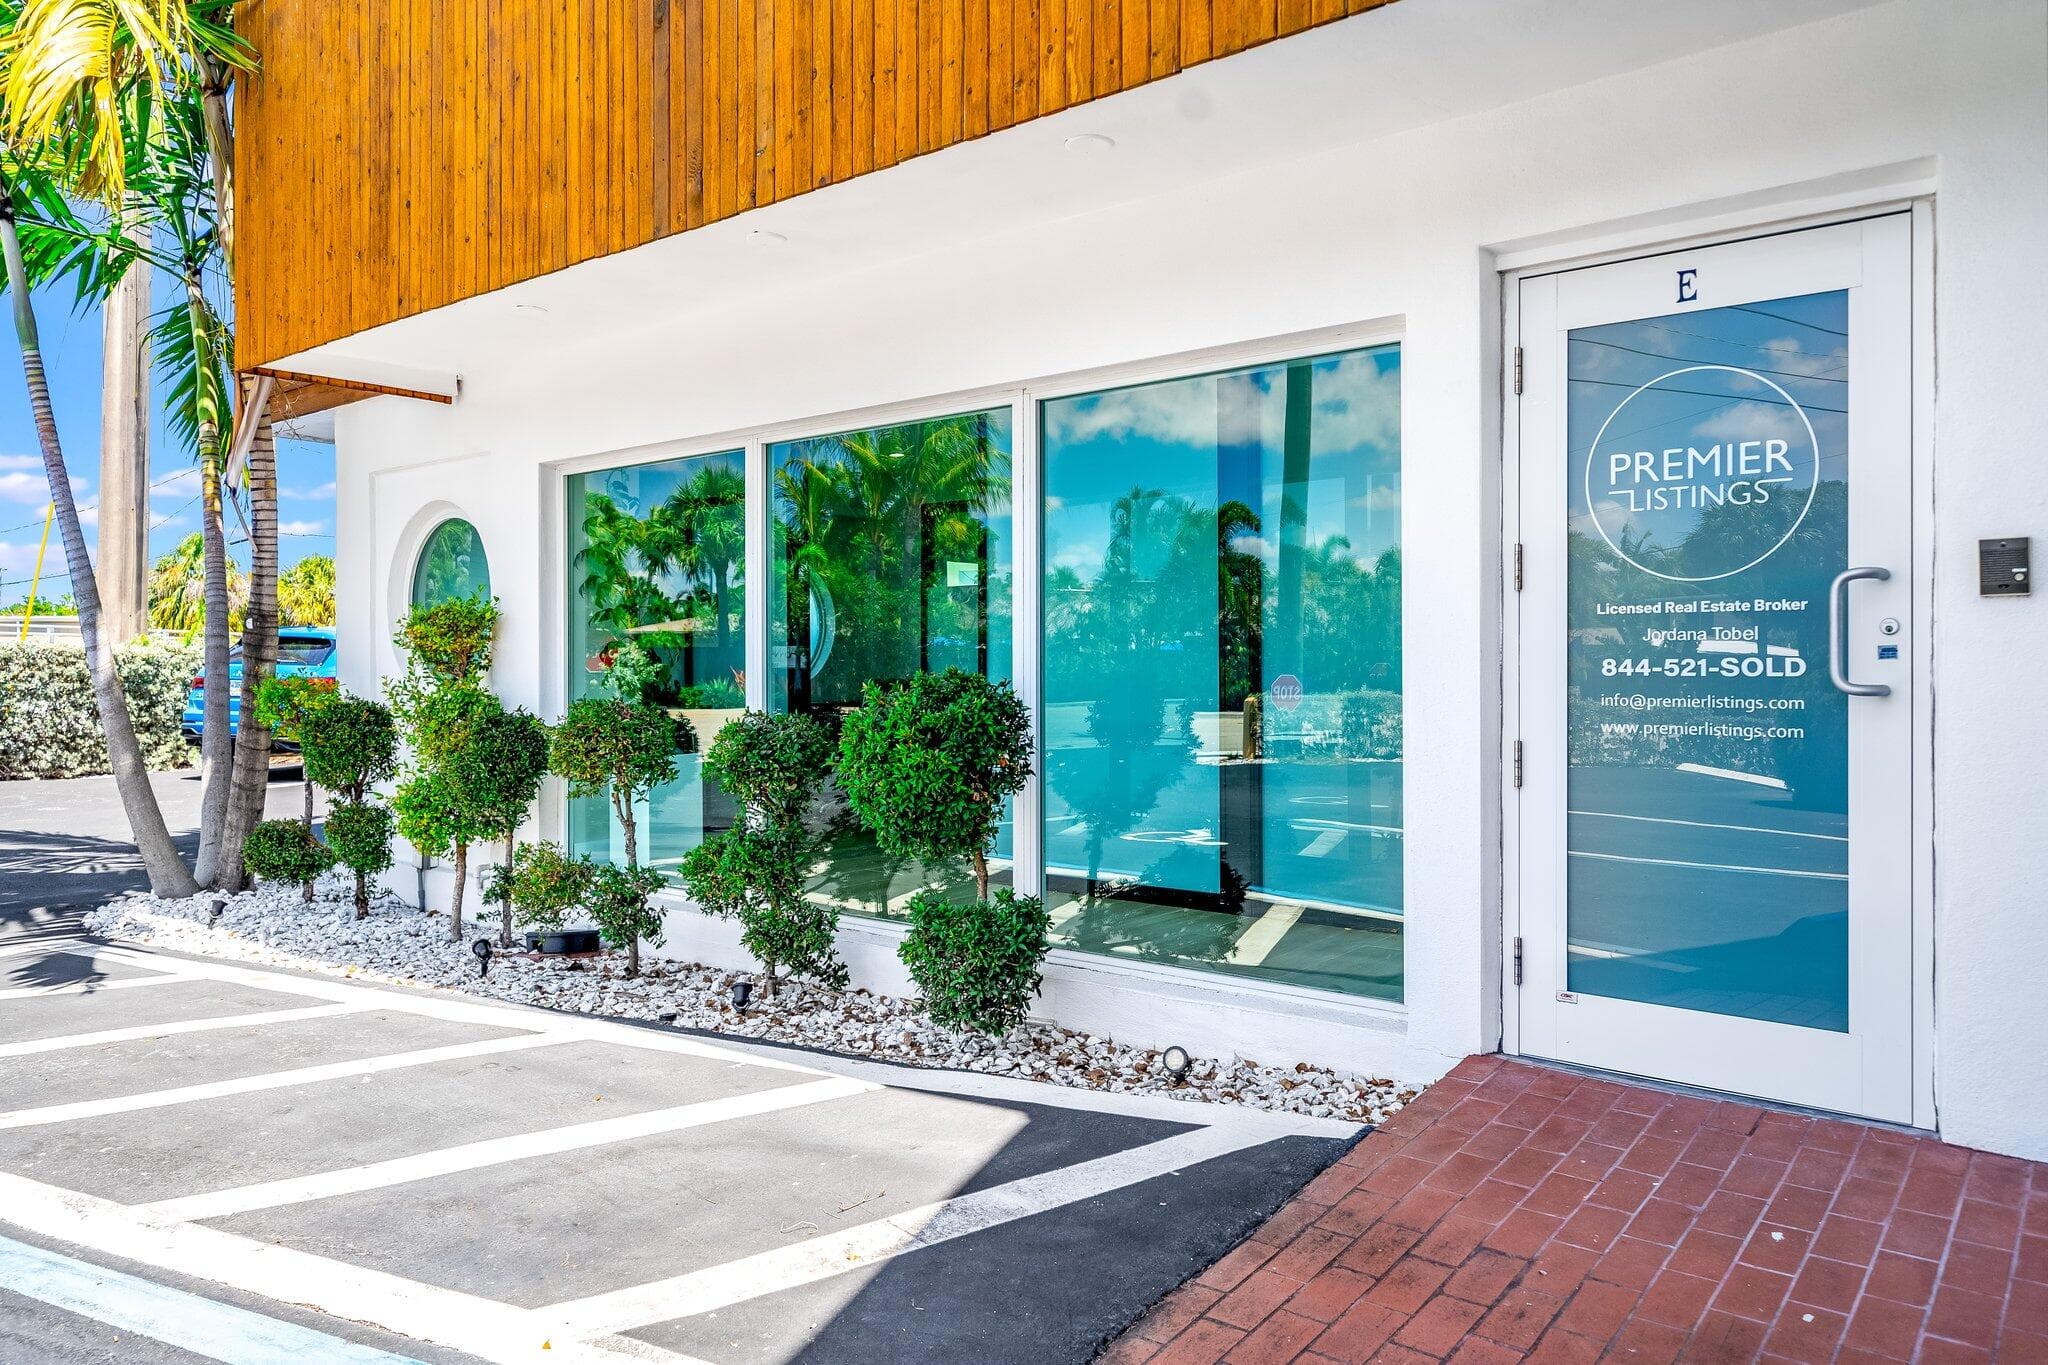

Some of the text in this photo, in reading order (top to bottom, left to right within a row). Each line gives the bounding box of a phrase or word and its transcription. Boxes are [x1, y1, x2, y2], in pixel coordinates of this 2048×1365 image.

[1676, 269, 1698, 303] E
[1609, 439, 1793, 485] PREMIER
[1608, 477, 1793, 512] LISTINGS
[1597, 599, 1808, 615] Licensed Real Estate Broker
[1643, 626, 1759, 641] Jordana Tobel
[1601, 657, 1807, 677] 844-521-SOLD
[1601, 694, 1805, 712] info@premierlistings.com
[1600, 722, 1804, 740] www.premierlistings.com
